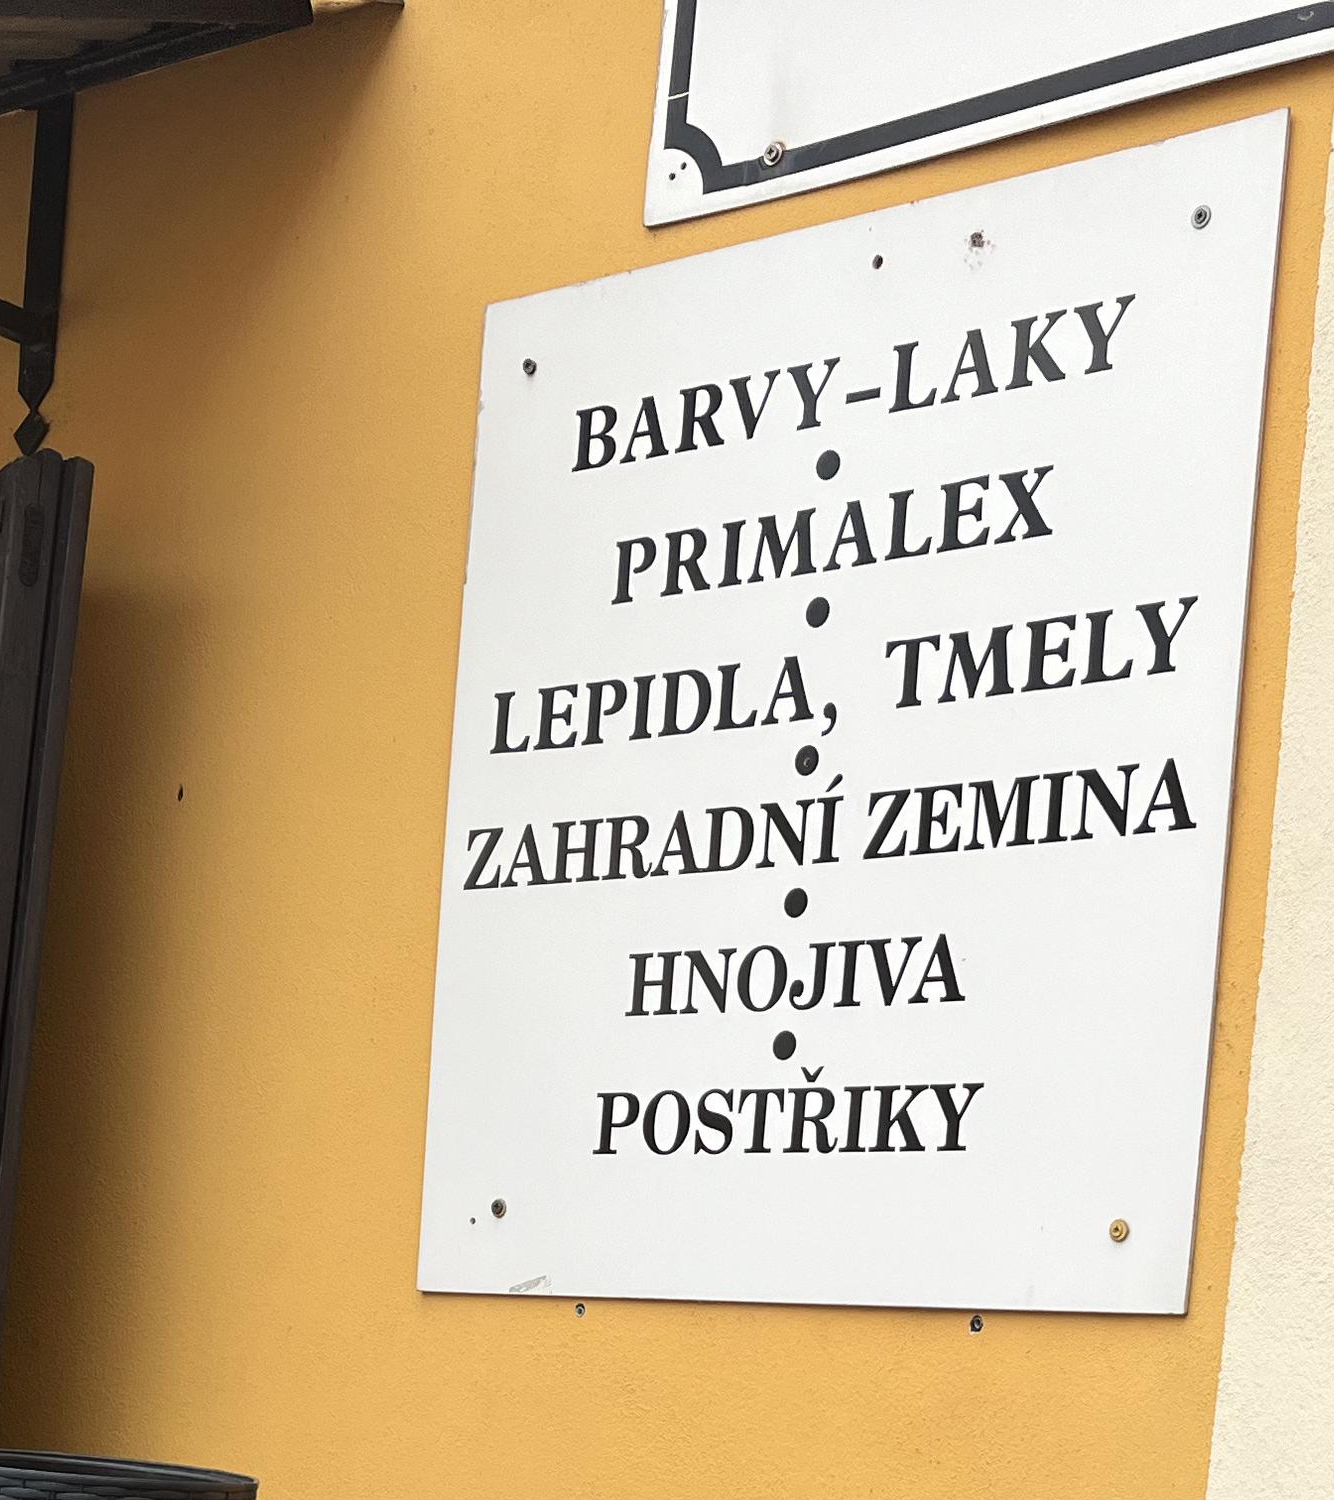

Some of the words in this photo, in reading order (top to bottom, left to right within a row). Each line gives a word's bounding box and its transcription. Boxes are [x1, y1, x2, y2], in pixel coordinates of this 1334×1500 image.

[572, 294, 1137, 472] BARVY-LAKY
[611, 464, 1055, 605] PRIMALEX
[489, 654, 838, 755] LEPIDLA,
[886, 595, 1199, 710] TMELY
[462, 773, 845, 890] ZAHRADNÍ
[862, 757, 1197, 861] ZEMINA
[624, 933, 966, 1017] HNOJIVA
[592, 1065, 985, 1155] POSTŘIKY
